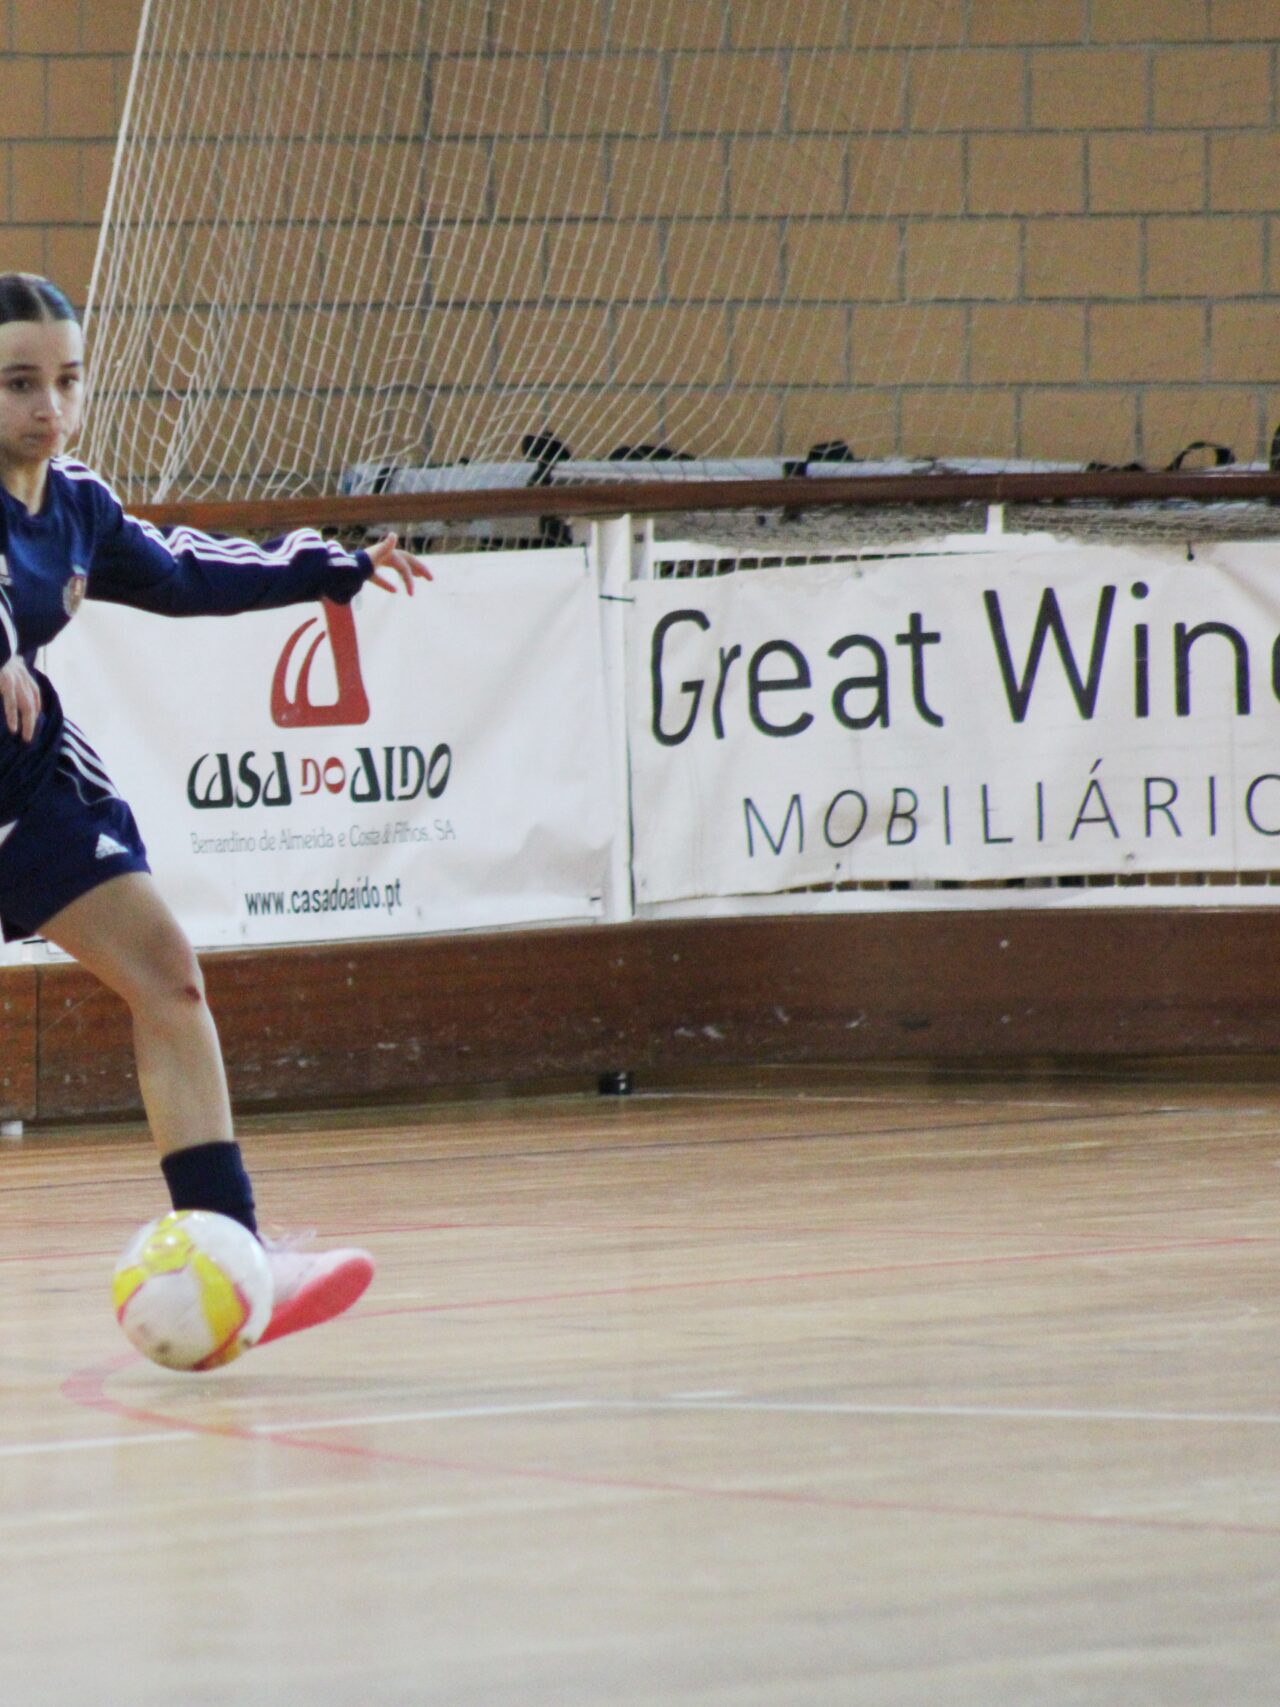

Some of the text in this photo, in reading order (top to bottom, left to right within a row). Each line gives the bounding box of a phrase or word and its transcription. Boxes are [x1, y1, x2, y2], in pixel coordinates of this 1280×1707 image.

[650, 581, 1280, 746] Great Win
[187, 743, 452, 809] CASA DO AIDO
[190, 831, 255, 854] Bernardino
[260, 830, 276, 851] de
[279, 826, 334, 849] Almeida
[337, 831, 346, 848] e
[434, 817, 456, 841] SA
[244, 876, 402, 916] www.casadoaido.pt
